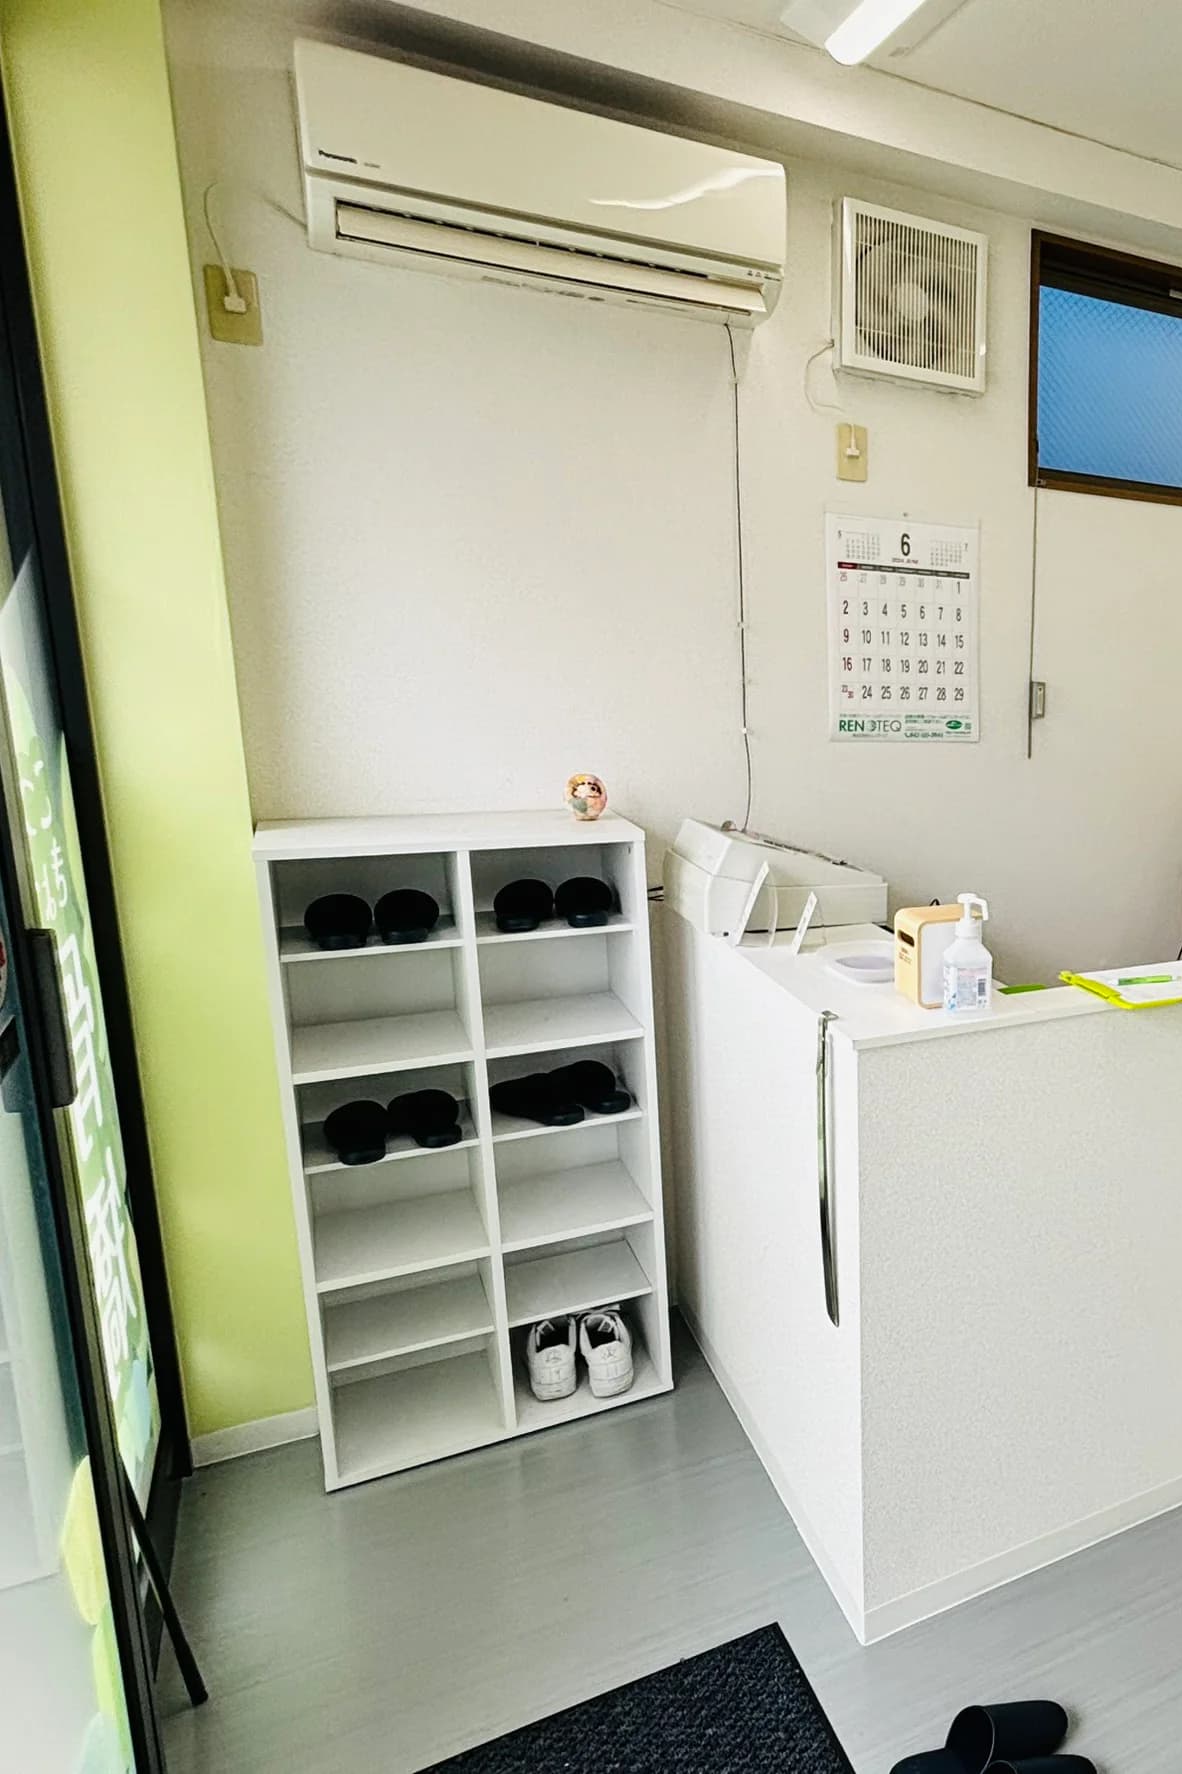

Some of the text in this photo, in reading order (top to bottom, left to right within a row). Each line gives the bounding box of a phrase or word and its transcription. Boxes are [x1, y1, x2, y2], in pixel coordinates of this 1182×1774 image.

[900, 533, 911, 556] 6
[956, 581, 961, 594] 1
[842, 600, 962, 622] 2 3 4 5 6 7 8
[843, 629, 965, 649] 9 10 11 12 13 14 15
[843, 657, 965, 676] 16 17 18 19 20 21 22
[862, 685, 873, 700] 24
[881, 686, 892, 700] 25
[900, 686, 911, 701] 26
[919, 687, 929, 701] 27
[937, 687, 947, 702] 28
[955, 688, 965, 702] 29
